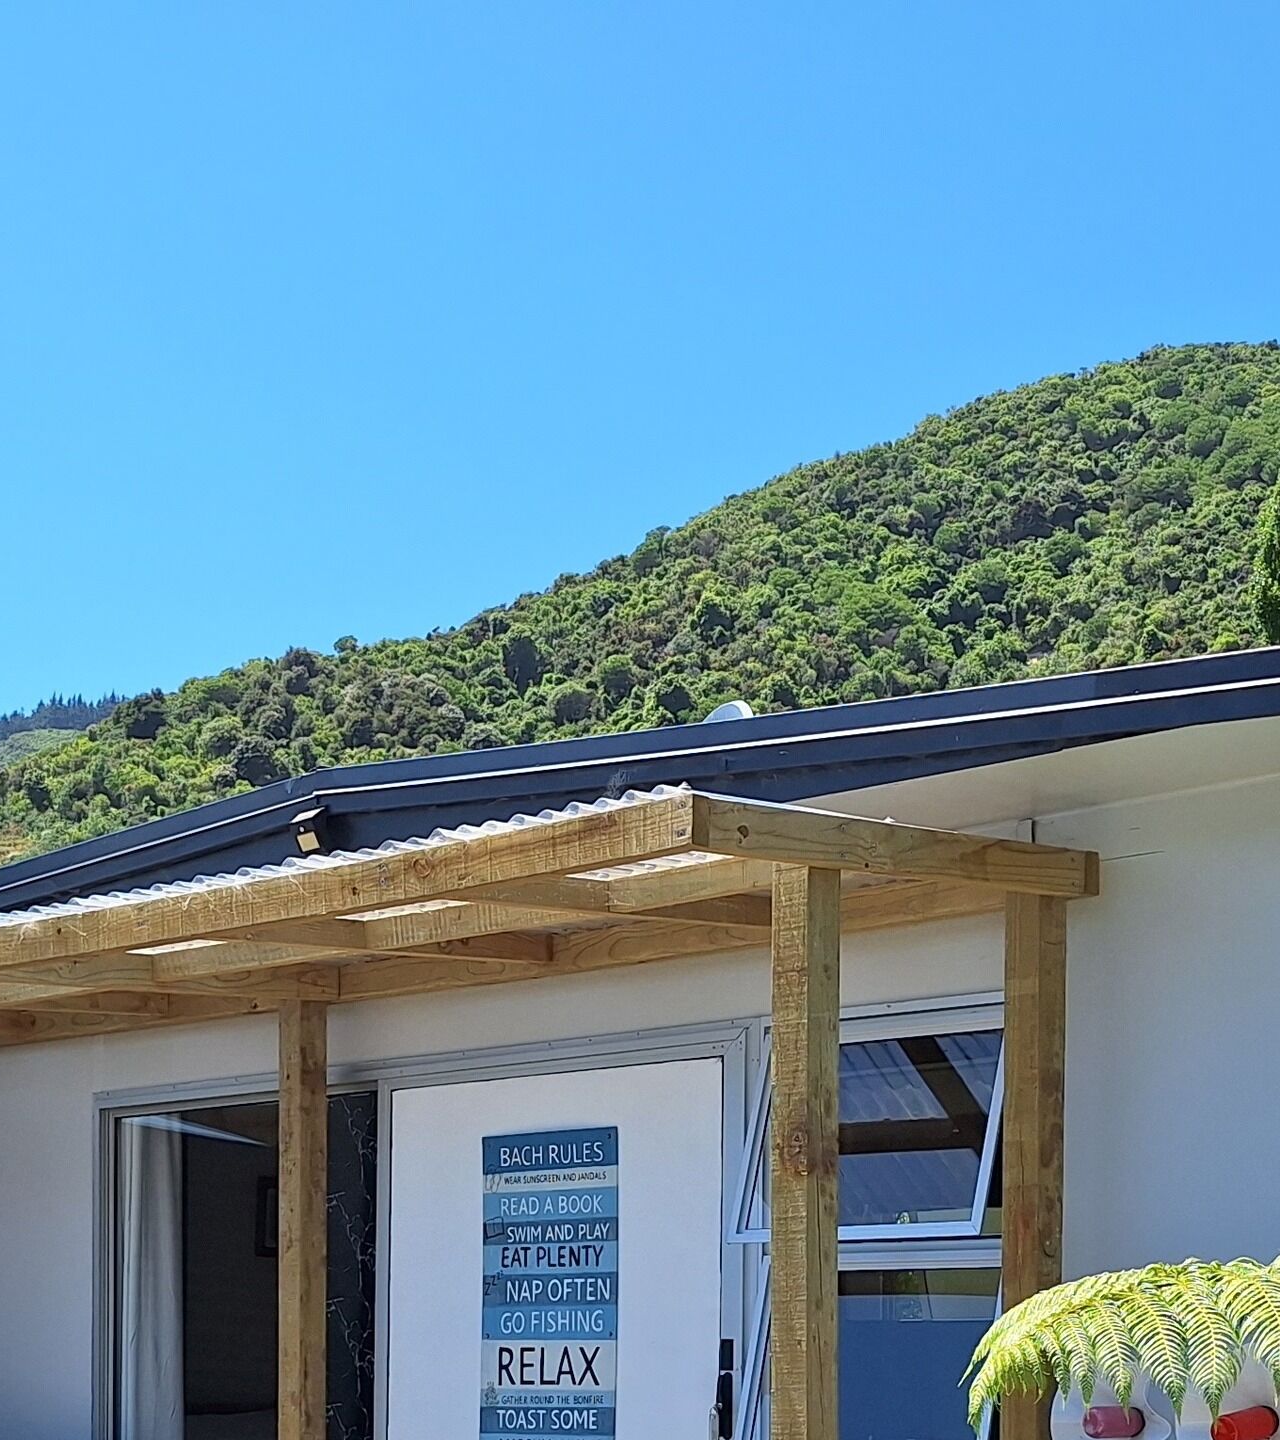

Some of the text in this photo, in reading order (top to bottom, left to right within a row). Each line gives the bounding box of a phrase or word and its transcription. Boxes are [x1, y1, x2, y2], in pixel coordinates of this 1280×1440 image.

[500, 1141, 604, 1167] BACH RULES
[504, 1170, 607, 1185] WEAR SUNSCREEN AND JANDALS
[500, 1194, 603, 1216] READ A BOOK
[507, 1222, 610, 1243] SWIM AND PLAY
[501, 1245, 604, 1268] EAT PLENTY
[506, 1278, 610, 1302] NAP OFTEN
[500, 1309, 603, 1334] GO FISHING
[498, 1346, 601, 1386] RELAX
[501, 1395, 528, 1405] GATHER
[557, 1395, 570, 1404] THE
[573, 1395, 604, 1405] BONFIRE
[496, 1409, 598, 1430] TOAST SOME
